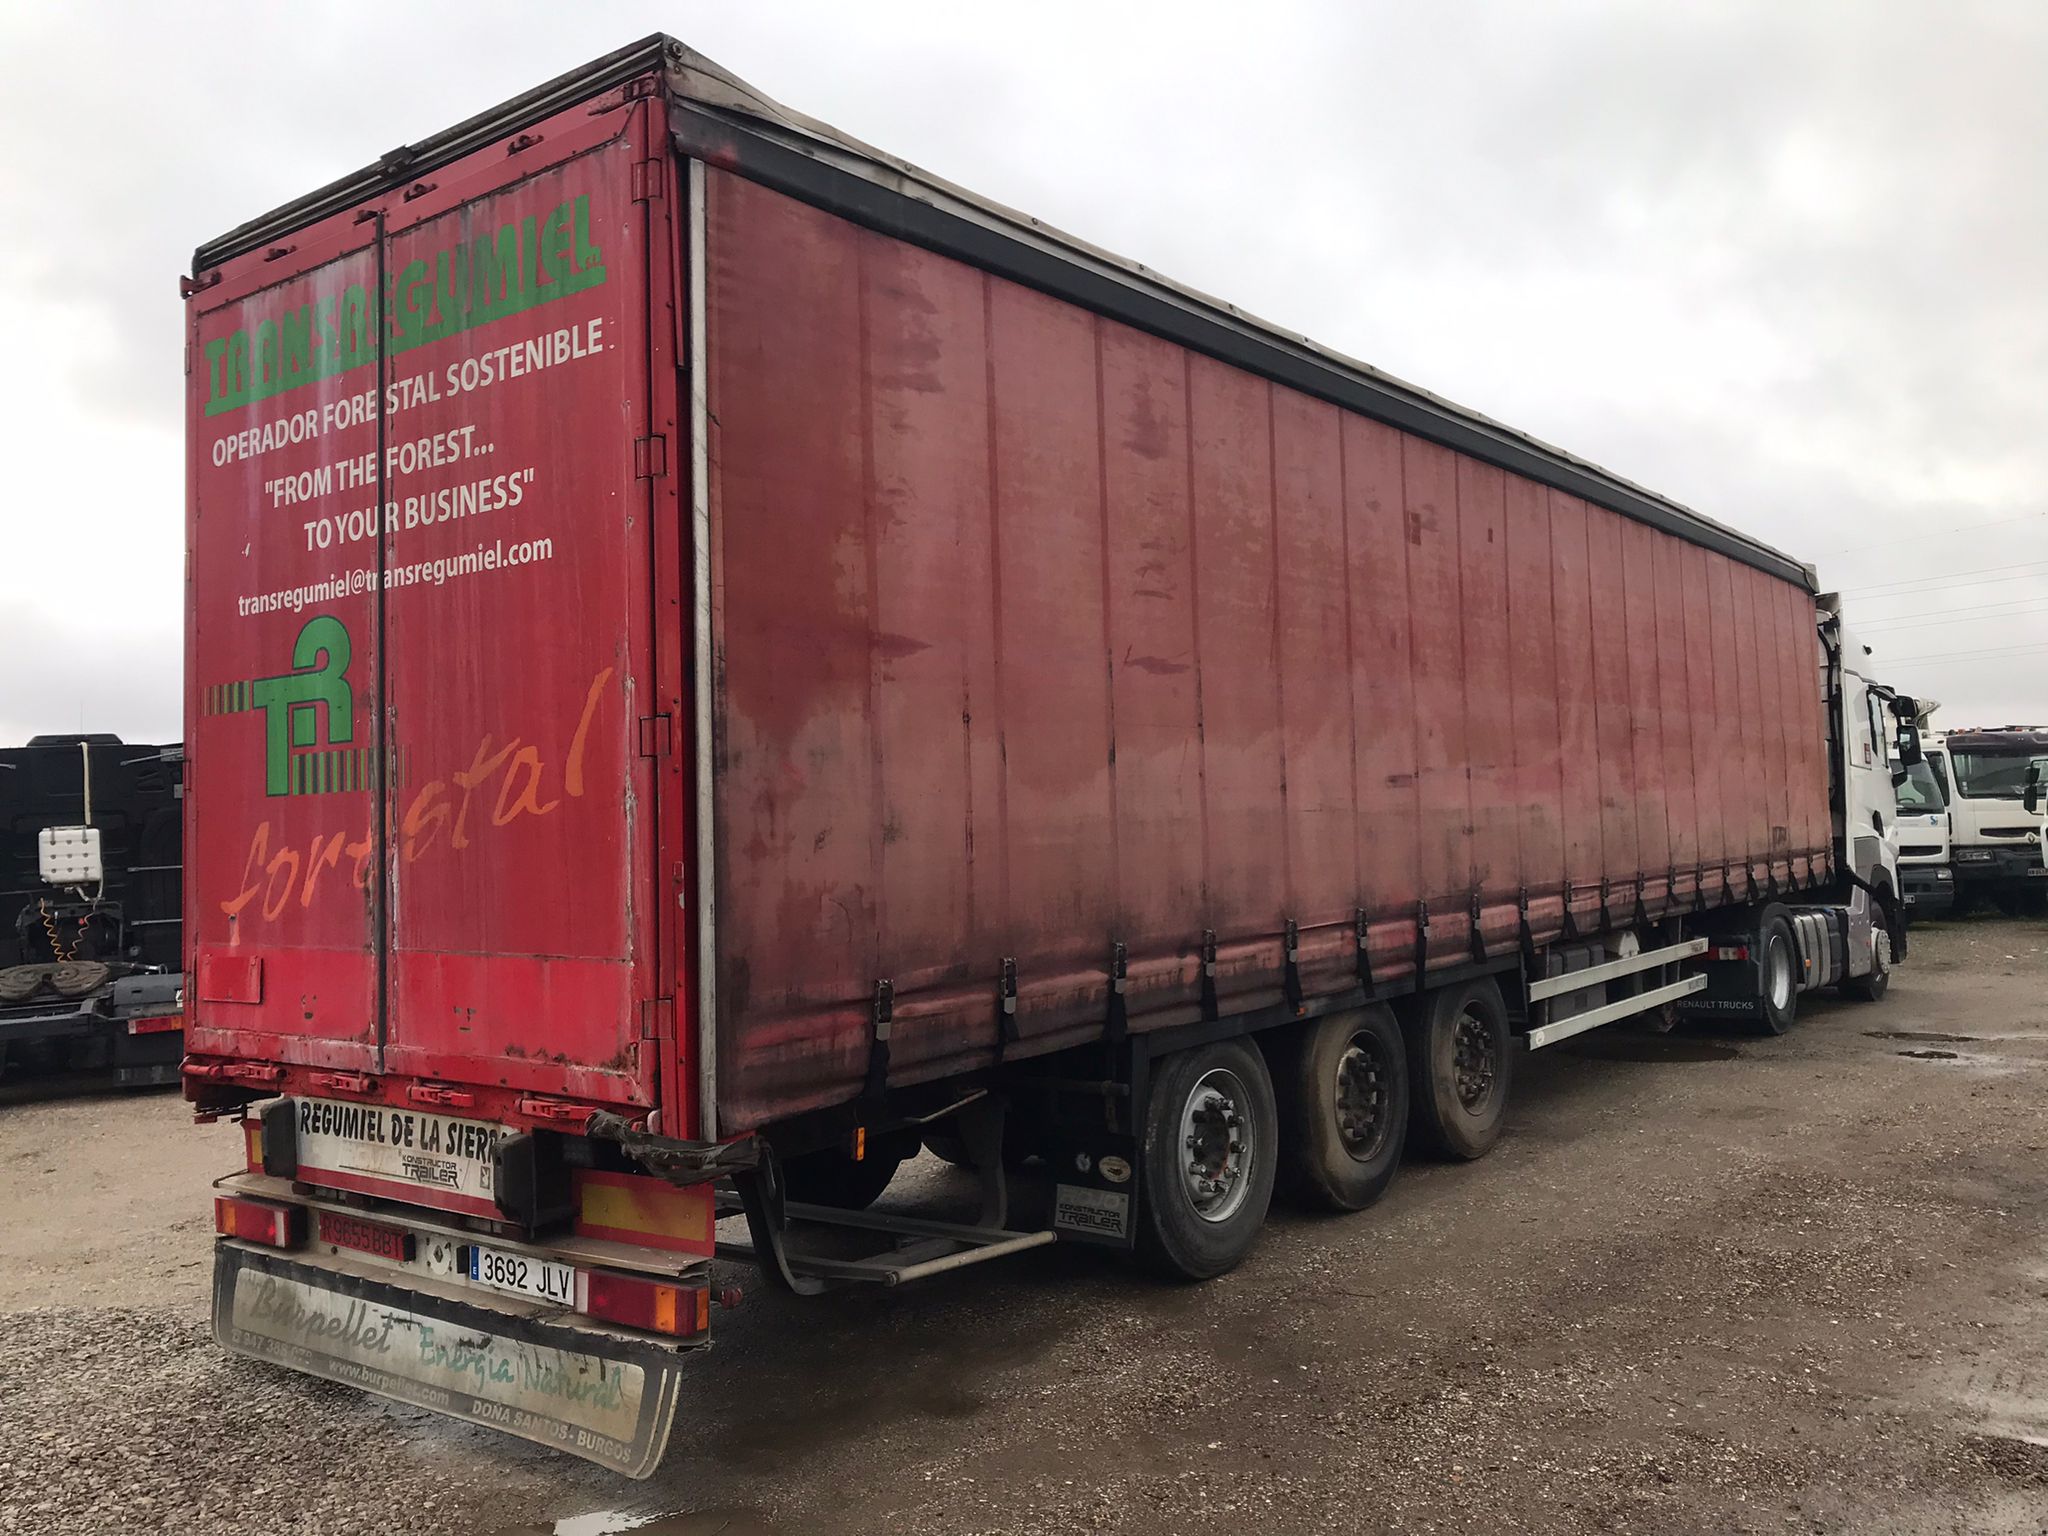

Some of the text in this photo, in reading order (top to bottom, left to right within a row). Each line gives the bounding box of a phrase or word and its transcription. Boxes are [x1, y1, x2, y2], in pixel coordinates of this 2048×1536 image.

[204, 193, 606, 416] TRANSREGUMIEL
[212, 412, 318, 467] OPERADOR
[446, 317, 604, 398] SOSTENIBLE
[264, 425, 494, 508] "FROM THE FOREST...
[303, 468, 535, 552] TO YOUR BUSINESS"
[237, 537, 553, 617] transregumiel@transregumiel.com
[1677, 1000, 1754, 1010] RENAULT TRUCKS
[300, 1101, 507, 1165] REGUMIEL DE LA SIERR
[484, 1253, 570, 1300] 3692 JLV
[577, 1430, 632, 1464] BURGOS
